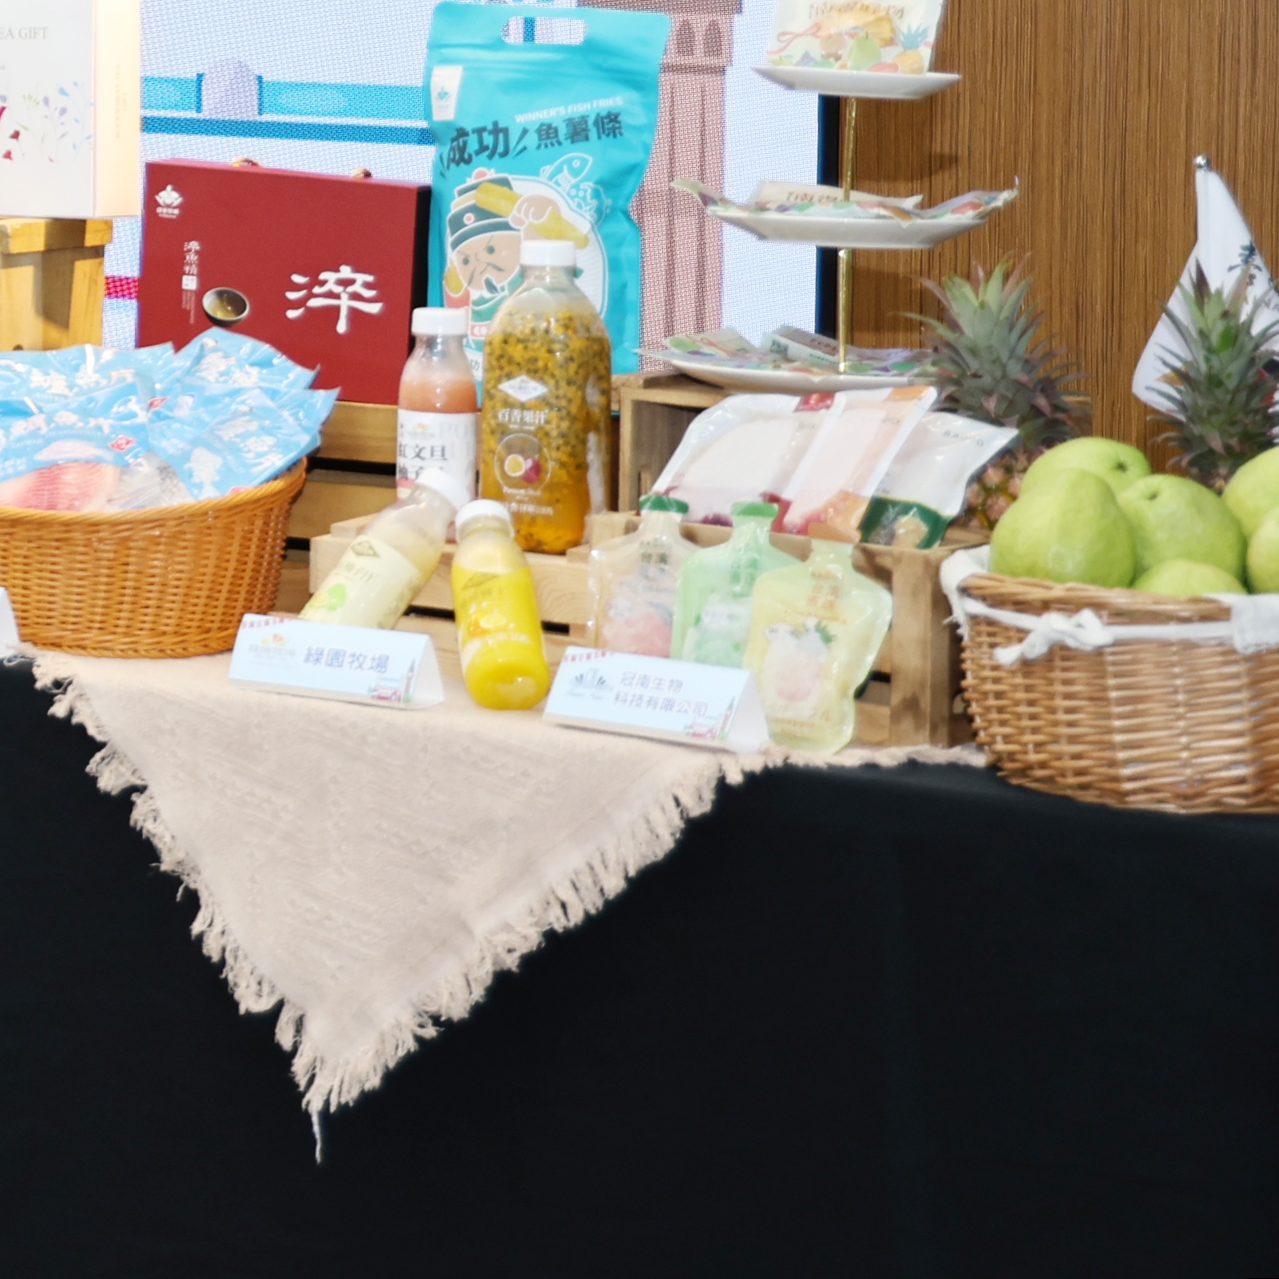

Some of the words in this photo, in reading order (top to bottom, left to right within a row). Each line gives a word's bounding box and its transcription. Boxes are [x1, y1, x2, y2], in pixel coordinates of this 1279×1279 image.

[18, 26, 48, 40] GIFT
[567, 100, 591, 114] FISH
[592, 95, 624, 108] FRIES
[535, 110, 624, 150] 魚薯條
[285, 264, 384, 335] 淬
[303, 645, 391, 674] 綠園牧場
[619, 671, 685, 693] 冠南生物
[613, 690, 709, 718] 科技有限公司
